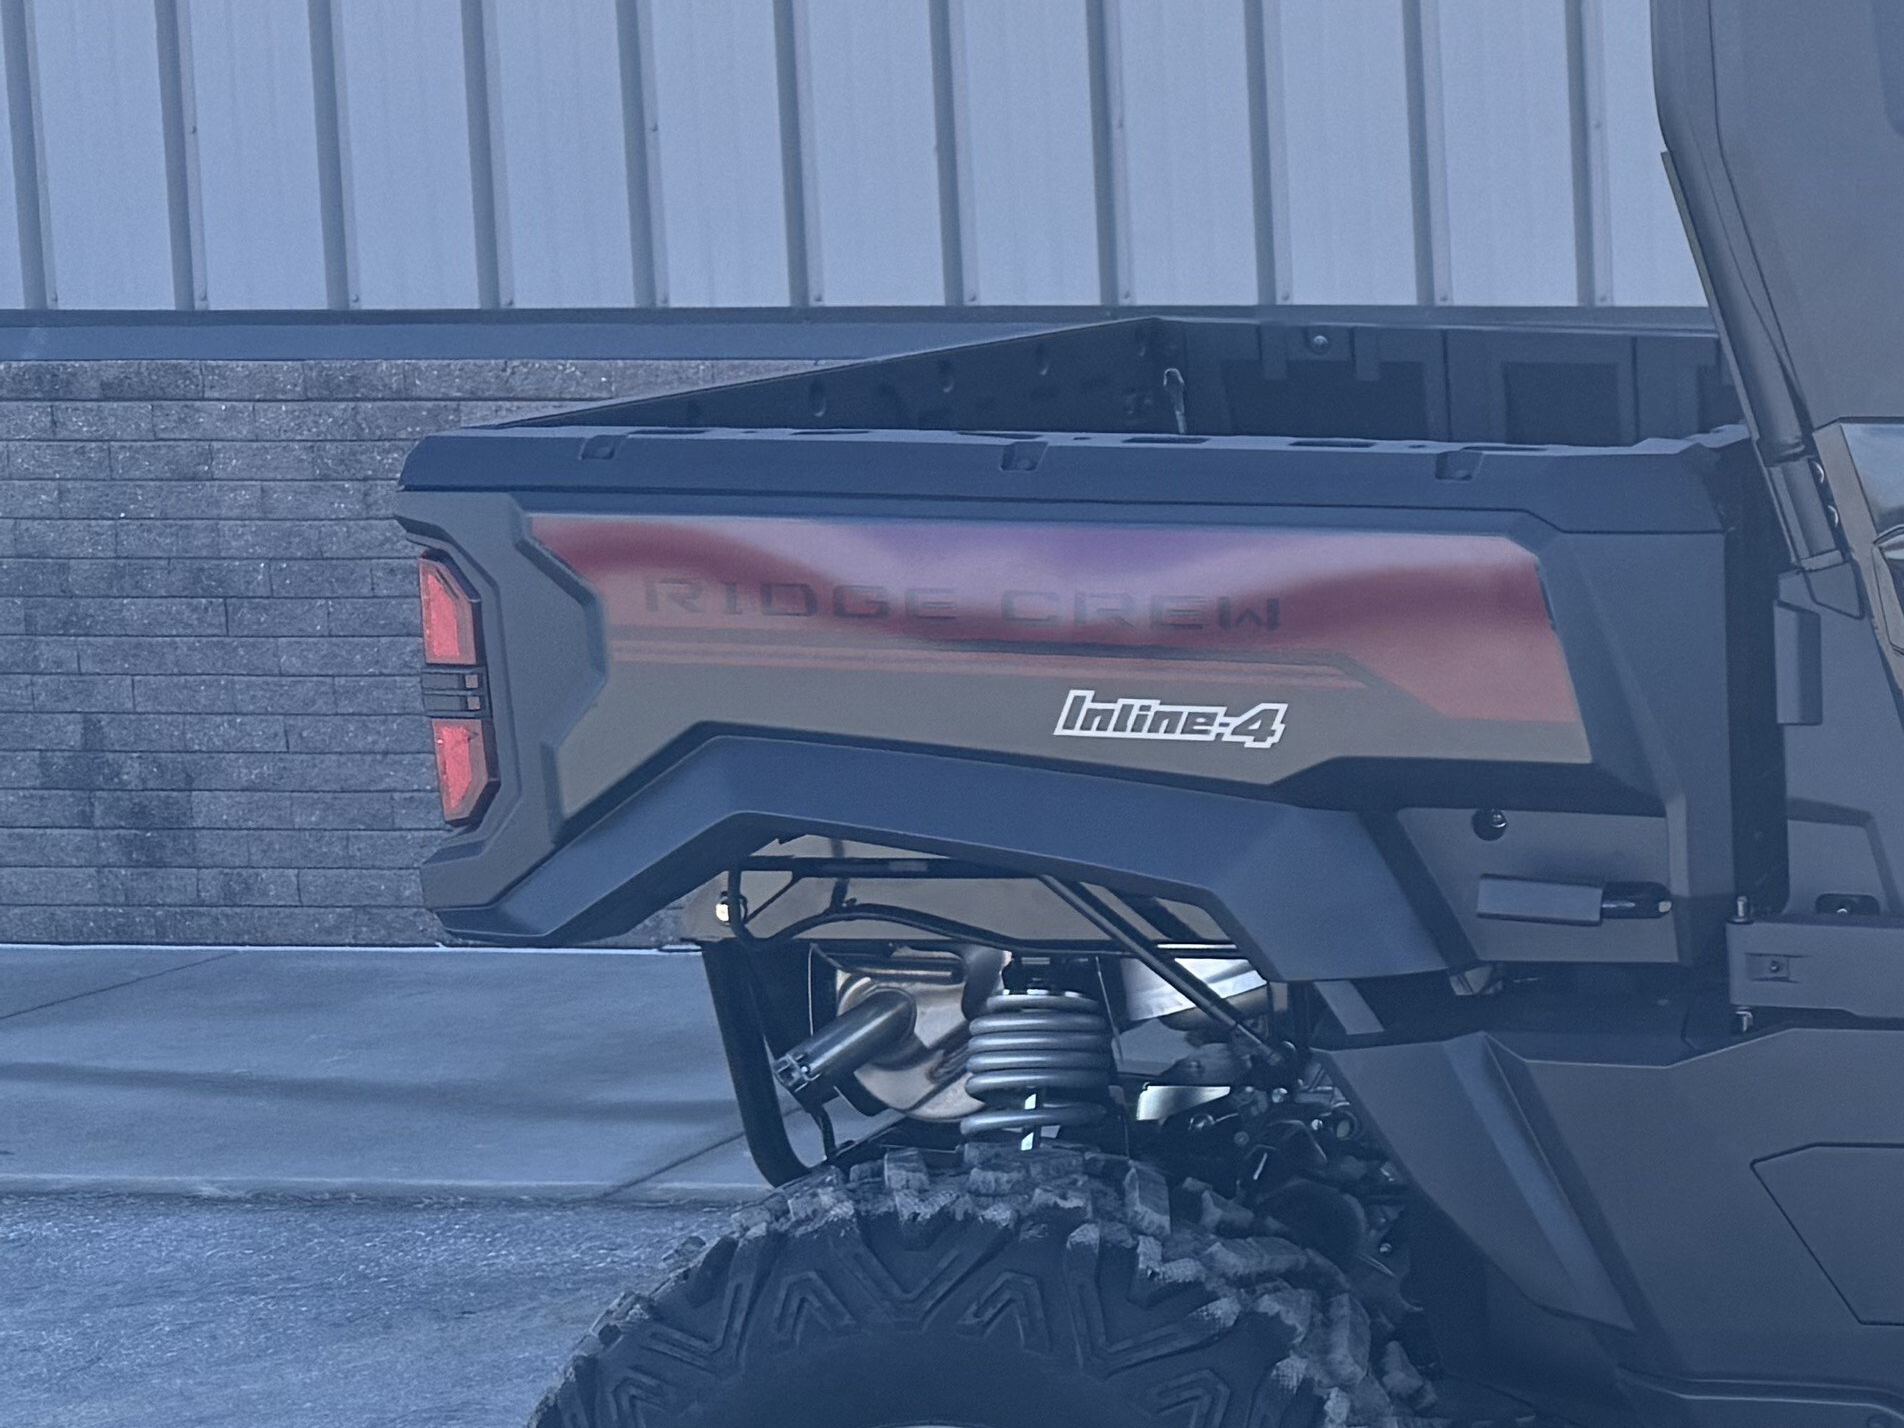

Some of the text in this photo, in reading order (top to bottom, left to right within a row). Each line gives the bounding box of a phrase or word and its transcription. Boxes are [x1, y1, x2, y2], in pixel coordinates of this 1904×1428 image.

[644, 577, 1280, 632] RIDGE CREW
[1052, 688, 1288, 749] Inline-4
